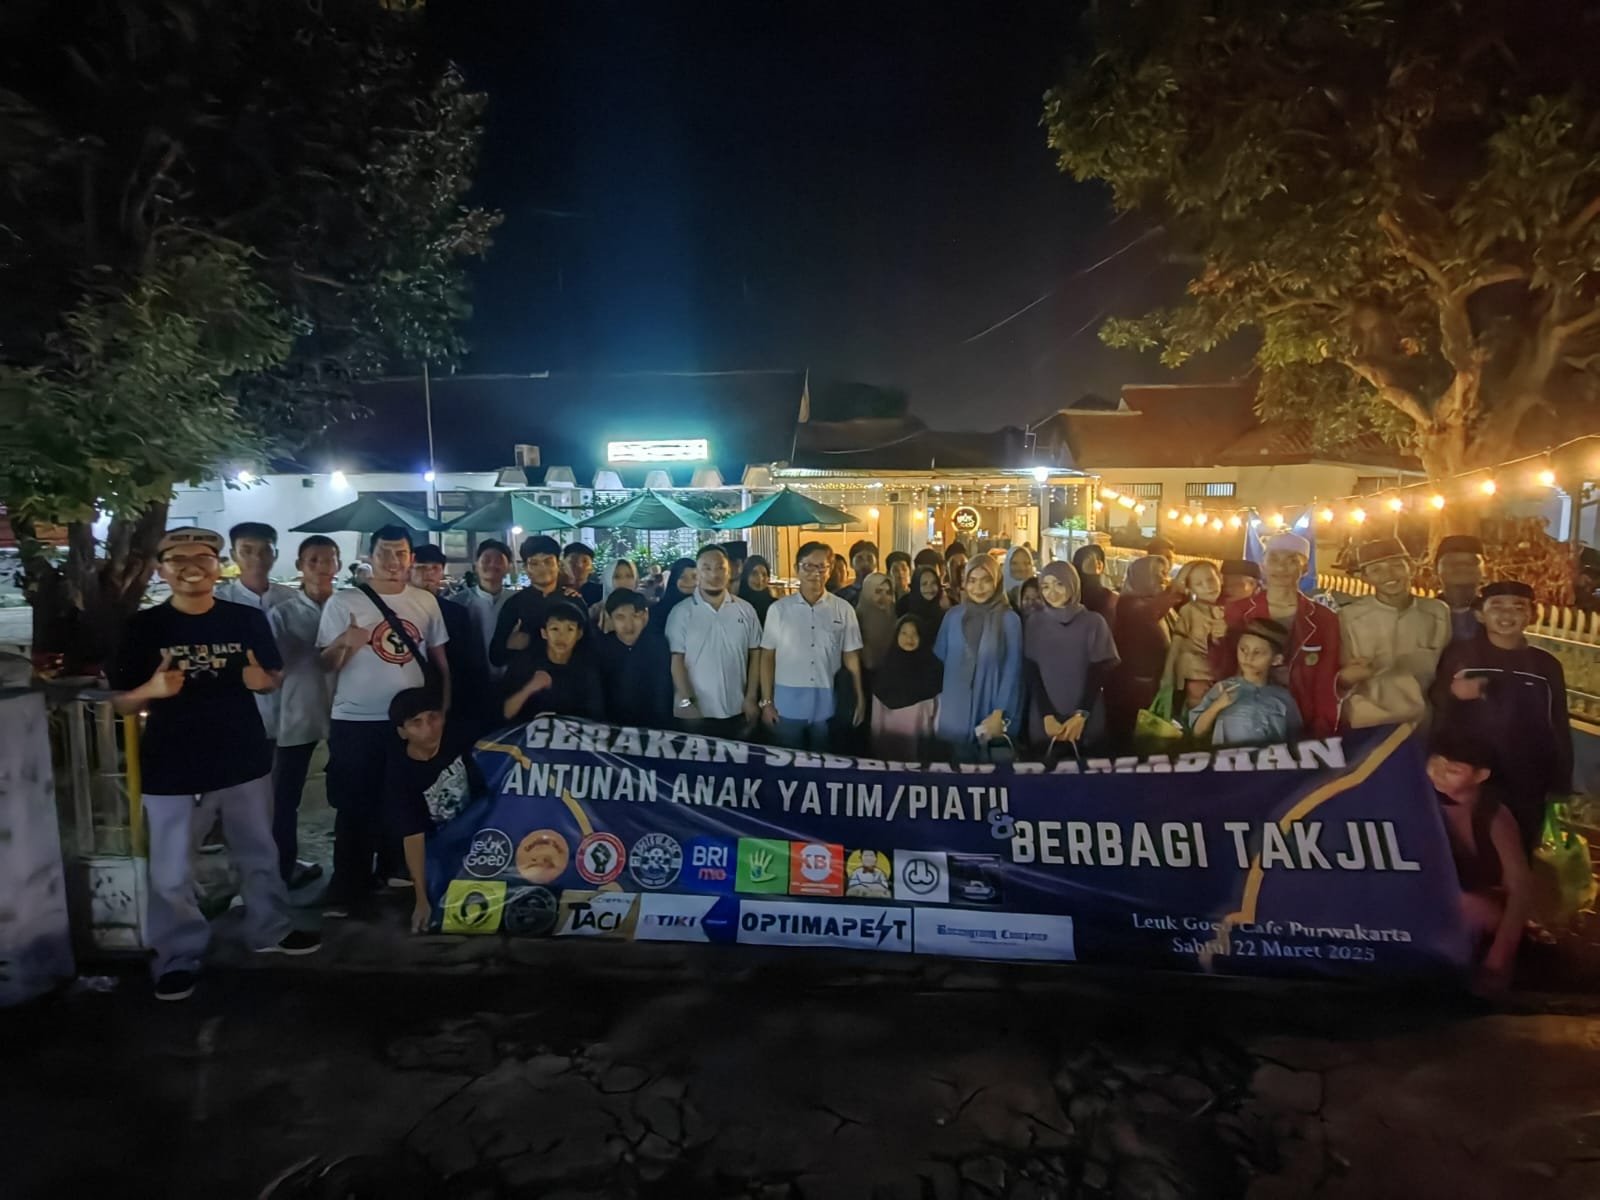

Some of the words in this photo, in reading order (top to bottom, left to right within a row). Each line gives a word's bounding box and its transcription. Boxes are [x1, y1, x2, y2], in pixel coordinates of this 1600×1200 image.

[672, 773, 763, 809] ANAK
[987, 808, 1015, 839] &
[1011, 821, 1209, 868] BERBAGI
[1223, 821, 1422, 871] TAKJIL
[692, 845, 728, 867] BRI
[568, 902, 622, 932] TACI
[656, 914, 697, 928] TIKI
[1132, 912, 1180, 931] Leuk
[1288, 920, 1413, 943] Purwakarta
[1233, 940, 1258, 956] 22
[1262, 940, 1324, 958] Maret
[1328, 944, 1376, 961] 2025
